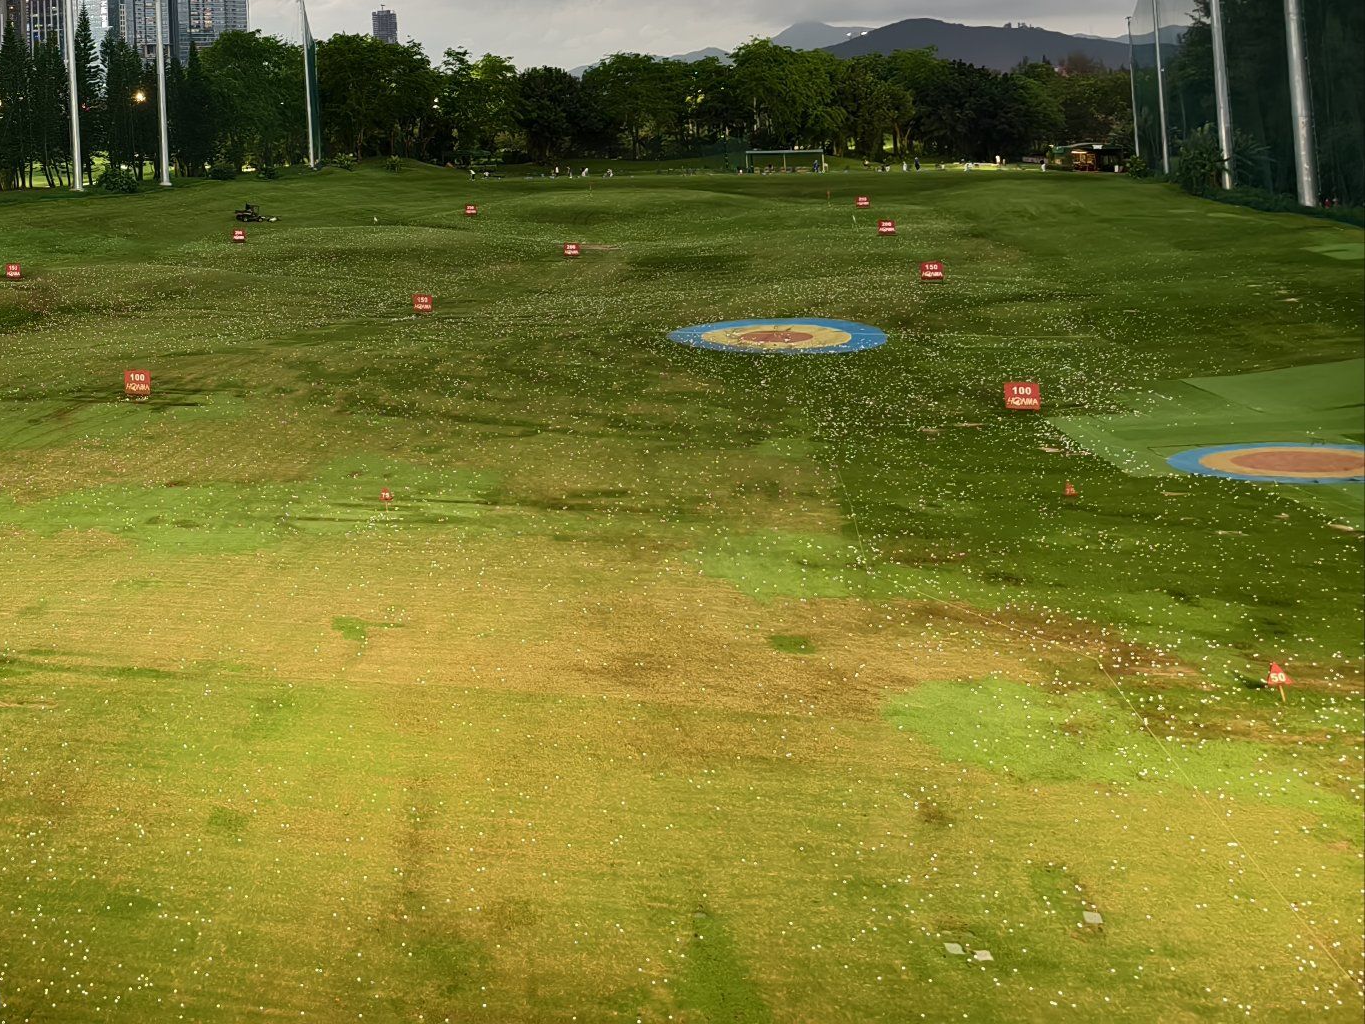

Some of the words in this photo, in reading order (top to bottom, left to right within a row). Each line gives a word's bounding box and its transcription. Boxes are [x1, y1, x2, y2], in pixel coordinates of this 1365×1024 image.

[130, 373, 145, 381] 100
[1012, 386, 1032, 395] 100
[1270, 672, 1286, 682] 50
